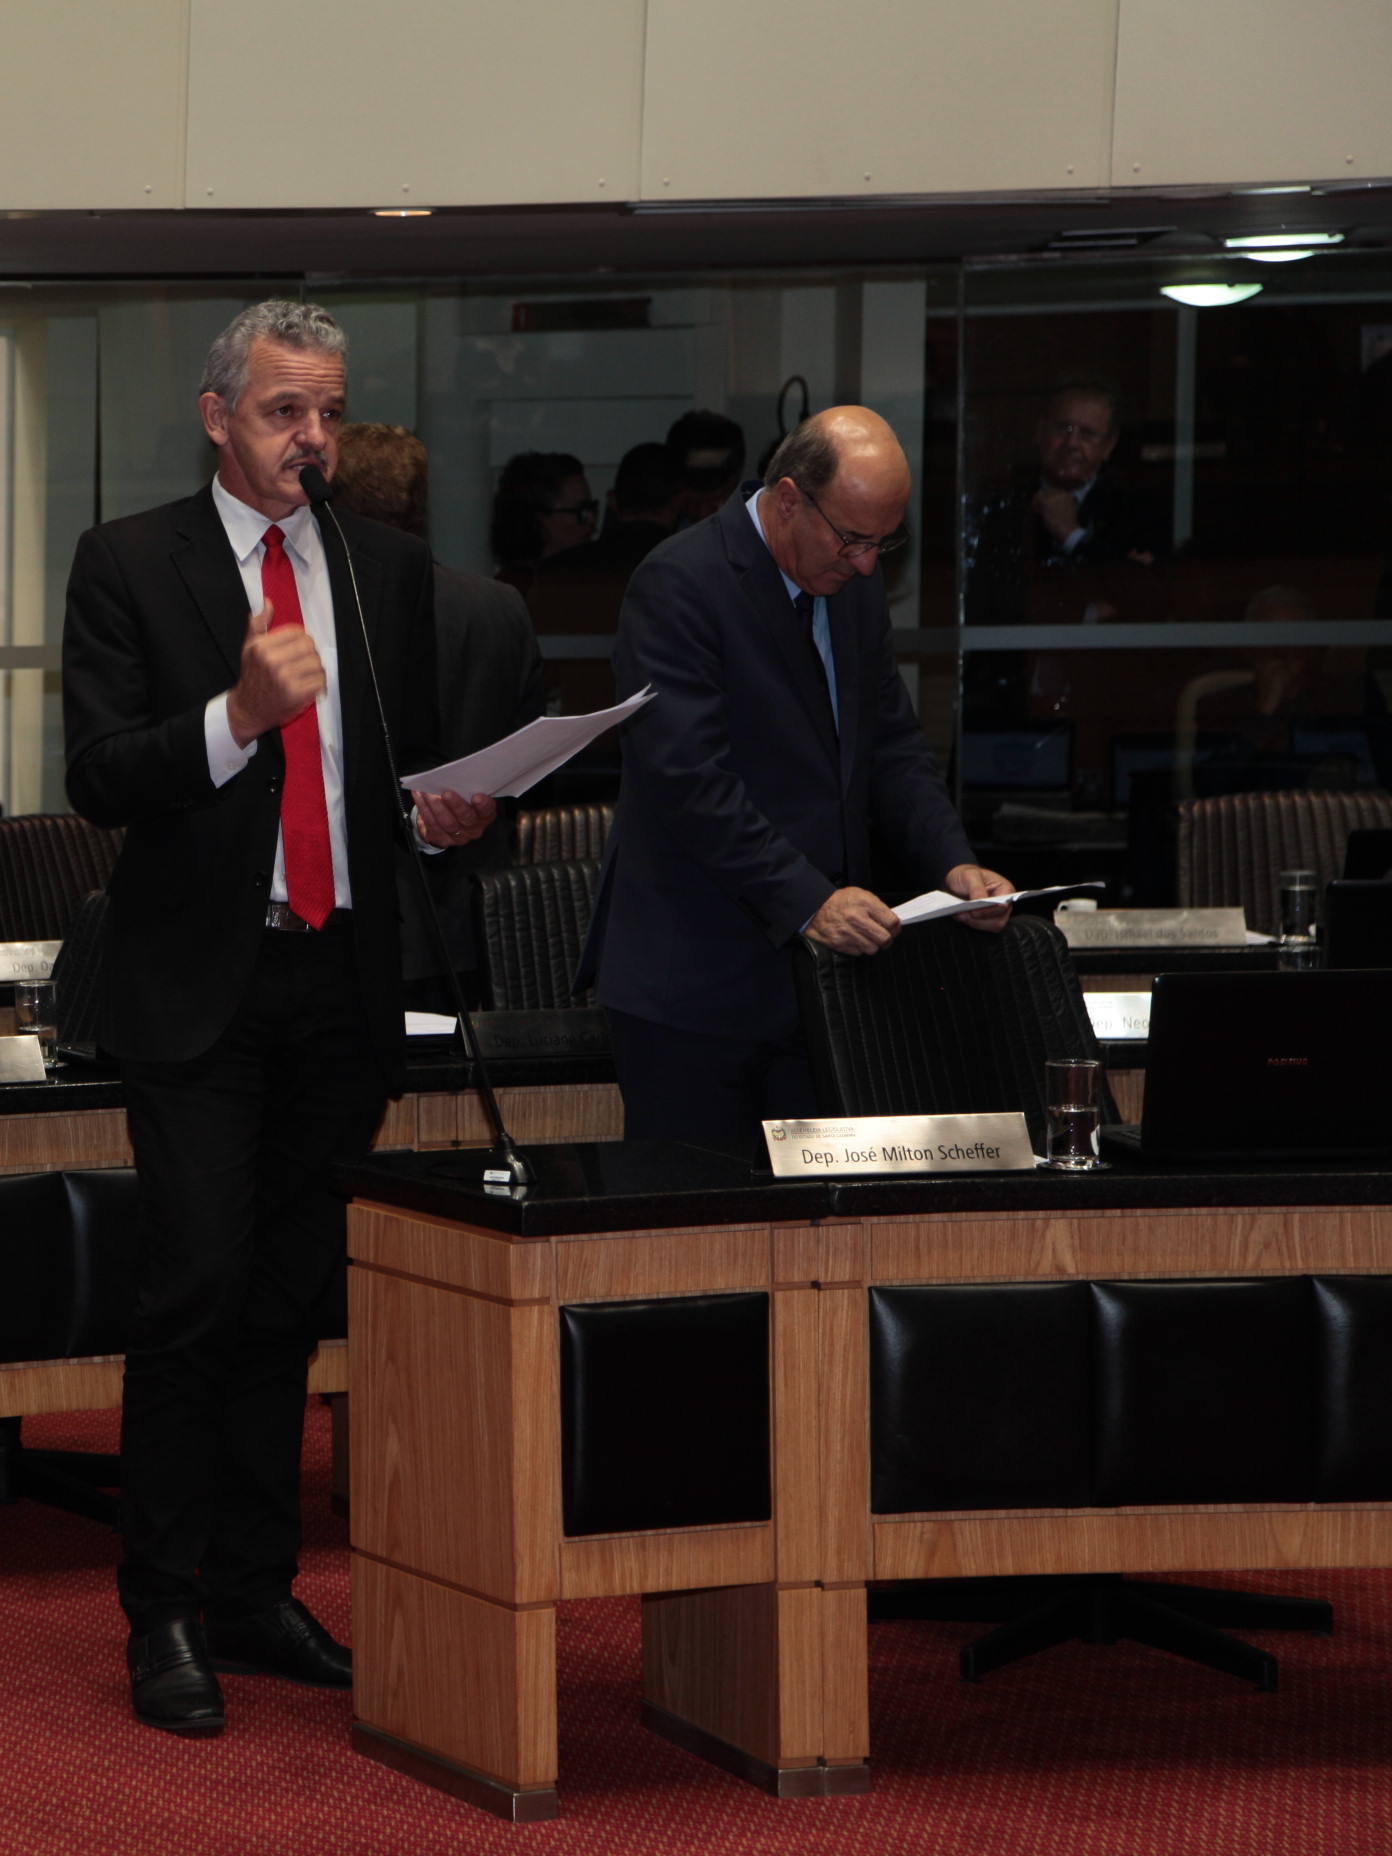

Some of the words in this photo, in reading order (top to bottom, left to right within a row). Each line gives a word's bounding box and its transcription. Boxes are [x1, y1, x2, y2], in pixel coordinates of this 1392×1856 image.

[13, 962, 38, 975] Dep.
[494, 1034, 525, 1049] Dep.
[801, 1148, 839, 1167] Dep.
[844, 1145, 878, 1163] José
[882, 1144, 933, 1162] Milton
[937, 1141, 1001, 1161] Scheffer
